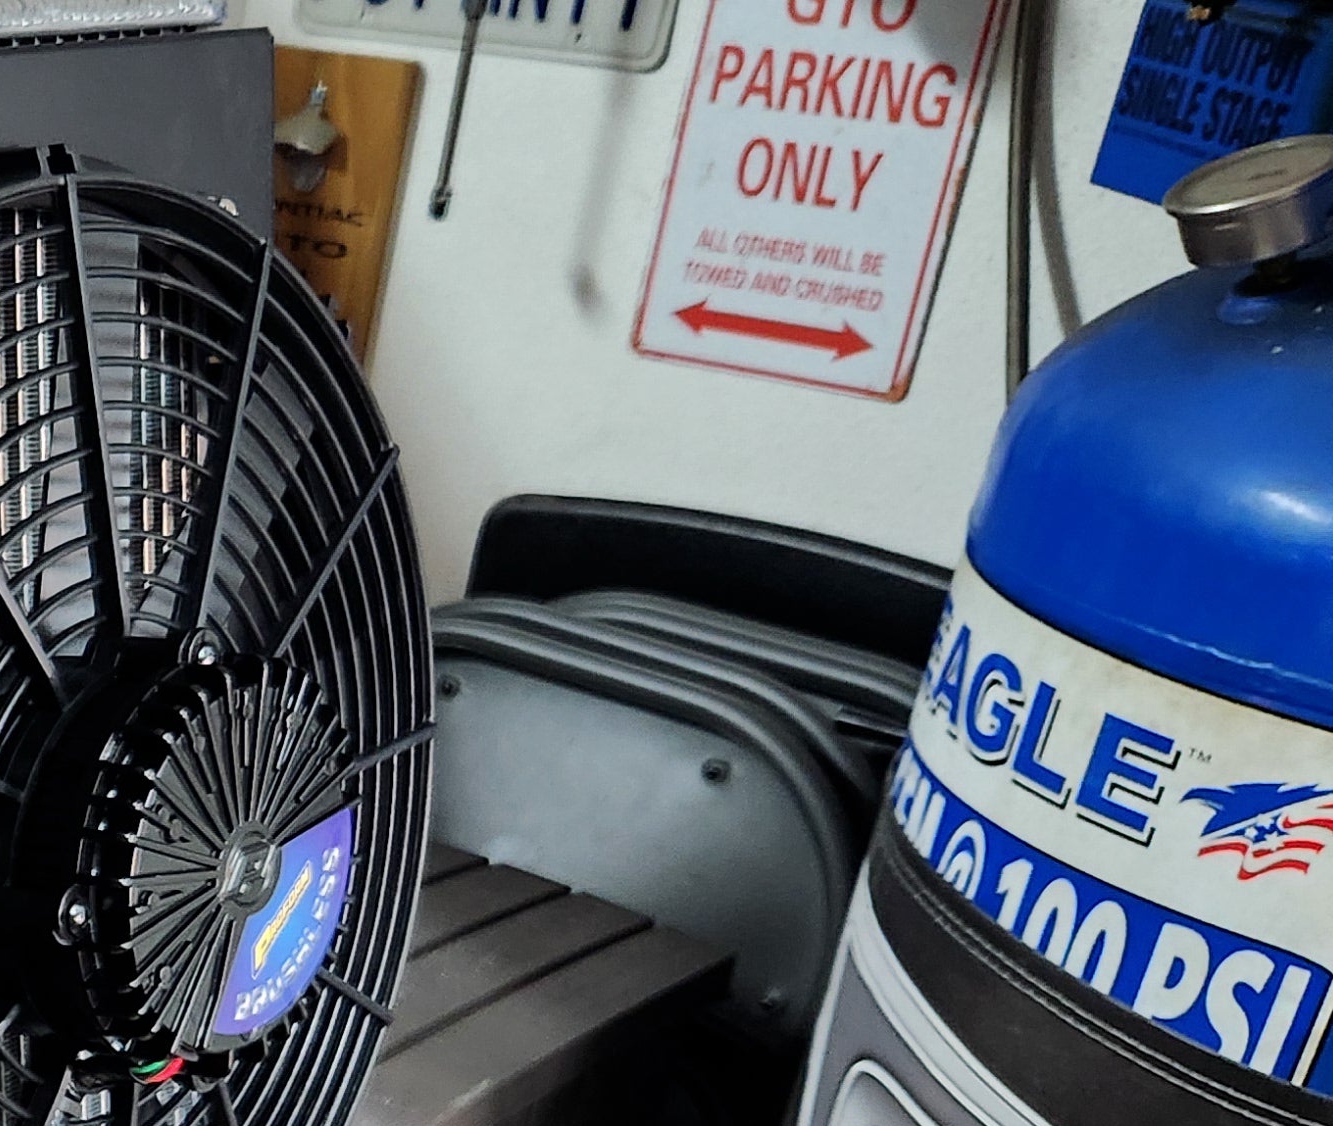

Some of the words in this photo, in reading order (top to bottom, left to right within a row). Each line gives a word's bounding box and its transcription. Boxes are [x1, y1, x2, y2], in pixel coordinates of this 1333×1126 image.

[709, 44, 958, 128] PARKING
[1119, 63, 1208, 134] SINGLE
[1201, 86, 1291, 147] STAGE
[737, 136, 884, 212] ONLY
[684, 257, 748, 289] TOWED
[749, 271, 792, 297] AND
[795, 276, 884, 312] CRUSHED
[695, 227, 728, 254] ALL
[734, 232, 807, 264] OTHERS
[811, 242, 854, 272] WILL
[858, 250, 886, 277] BE
[233, 846, 340, 1021] BRUSHLESS
[994, 856, 1128, 994] 100
[1131, 921, 1312, 1076] PSI
